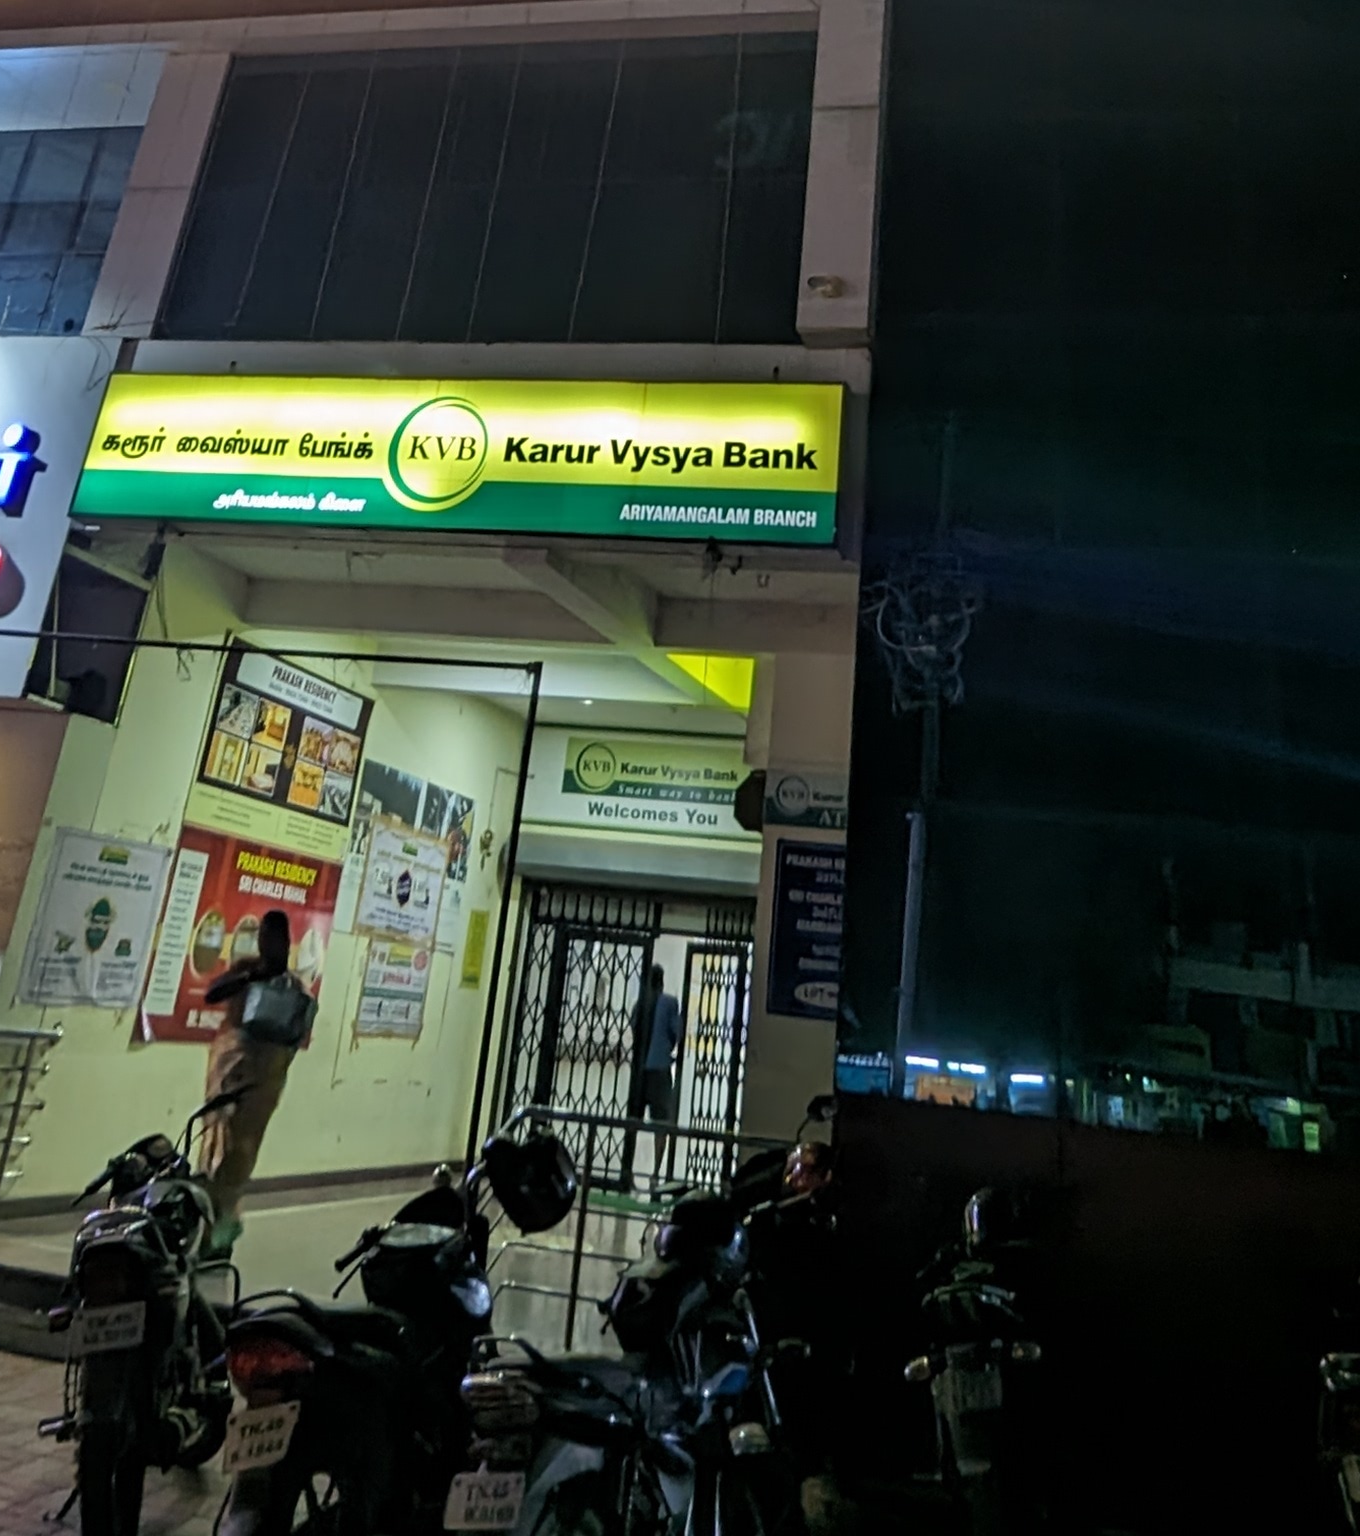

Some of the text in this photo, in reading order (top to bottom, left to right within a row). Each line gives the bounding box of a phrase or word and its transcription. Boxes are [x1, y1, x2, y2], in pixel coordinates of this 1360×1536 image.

[100, 427, 375, 460] கரூர் வைஸ்யா பேங்க்
[408, 435, 477, 462] KVB
[503, 437, 818, 474] Karur Vysya Bank
[620, 503, 818, 528] ARIYAMANGALAM BRANCH
[272, 665, 304, 690] PRAKASH
[621, 762, 738, 782] Karur Vysya Bank
[588, 802, 719, 825] Welcomes You
